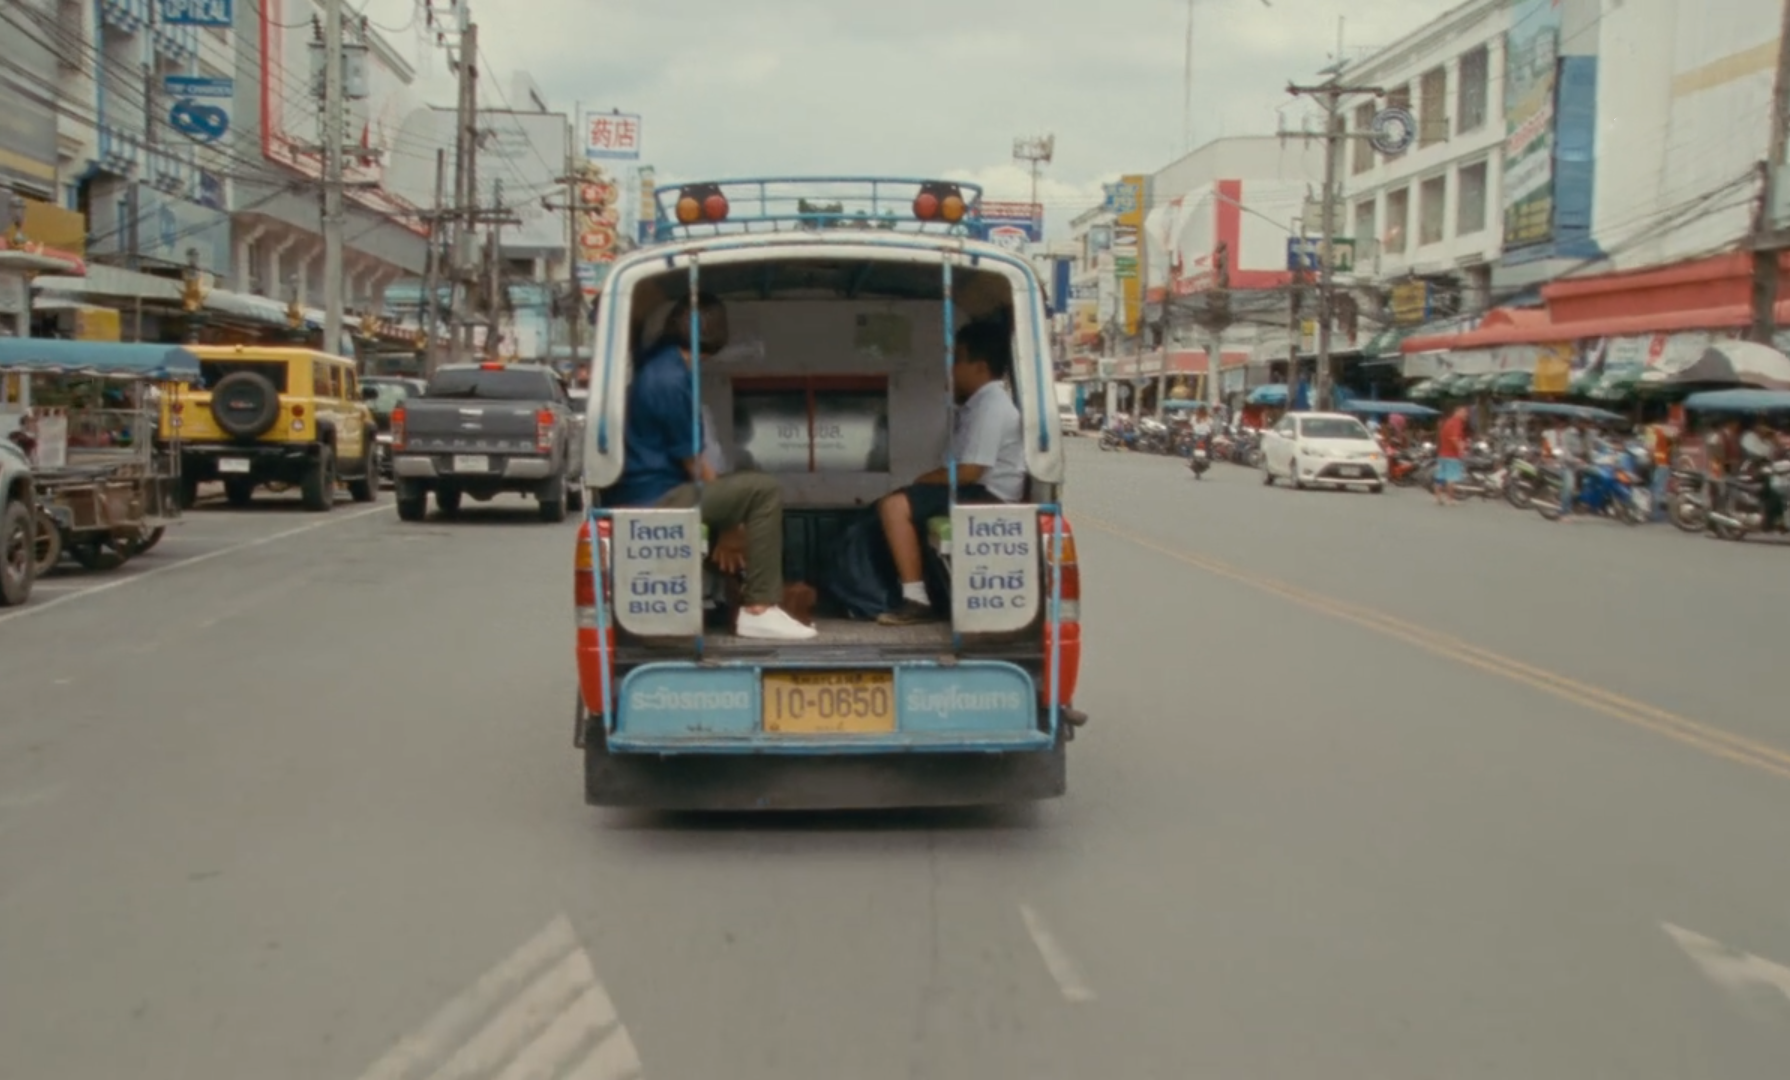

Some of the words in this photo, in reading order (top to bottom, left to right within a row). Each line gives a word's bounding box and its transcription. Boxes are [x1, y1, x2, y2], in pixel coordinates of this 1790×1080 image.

[591, 118, 637, 147] 药店
[627, 545, 692, 559] LOTUS
[965, 542, 1029, 556] LOTUS
[629, 600, 667, 614] BIG
[673, 600, 689, 613] C
[967, 596, 1004, 609] BIG
[1010, 595, 1026, 608] C
[776, 686, 888, 719] 10-0650
